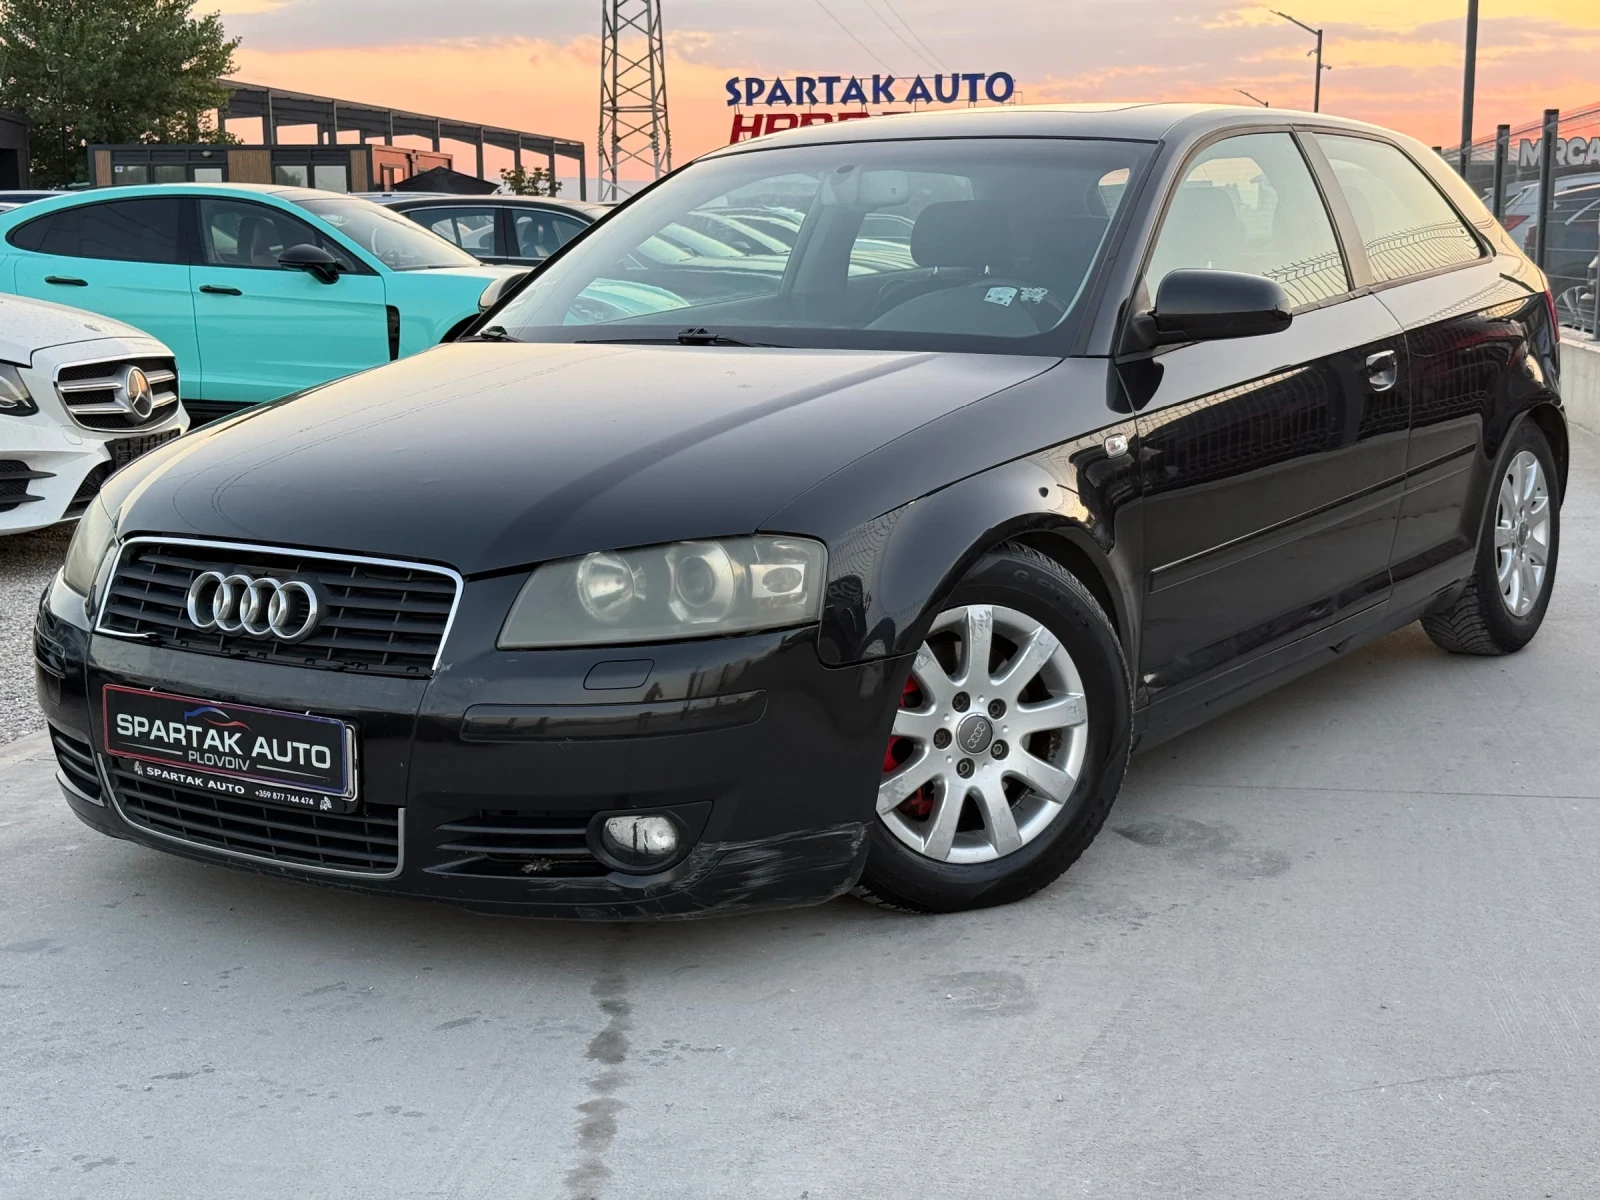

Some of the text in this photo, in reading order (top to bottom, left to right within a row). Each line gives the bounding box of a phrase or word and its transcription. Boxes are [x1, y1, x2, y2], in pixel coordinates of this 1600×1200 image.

[725, 71, 1014, 107] SPARTAK AUTO
[116, 713, 331, 769] SPARTAK AUTO
[188, 750, 250, 771] PLOVDIV
[146, 767, 314, 805] SPARTAK AUTO +359 877 744 474
